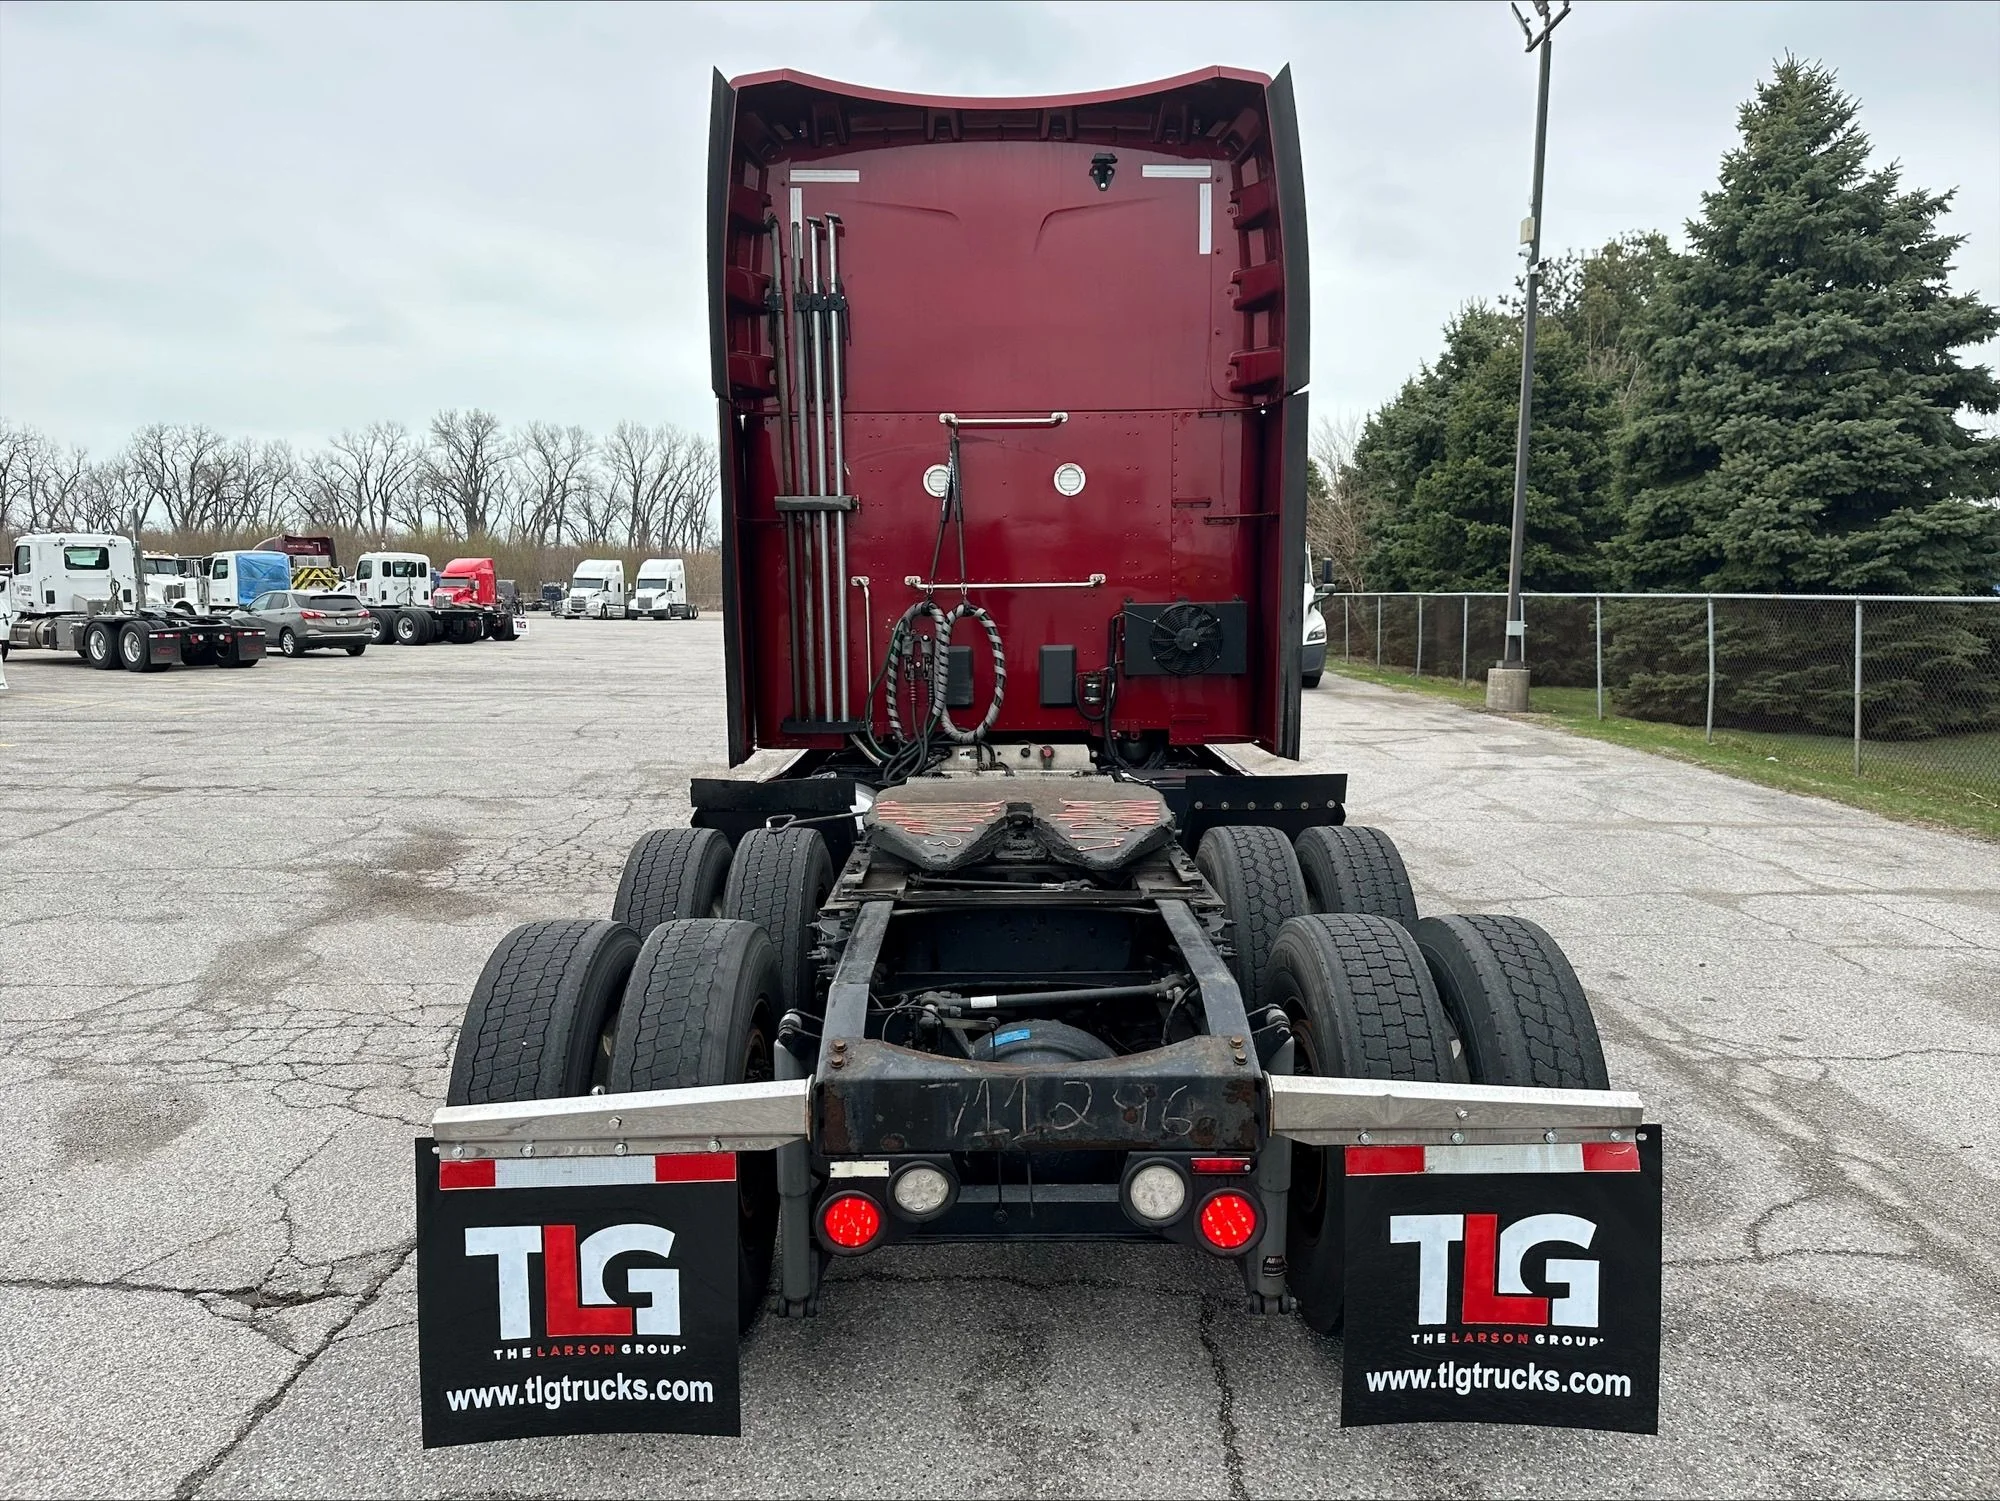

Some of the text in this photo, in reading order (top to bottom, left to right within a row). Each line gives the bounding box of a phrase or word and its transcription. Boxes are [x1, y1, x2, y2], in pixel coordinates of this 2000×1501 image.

[464, 1223, 682, 1341] TLG
[1389, 1213, 1600, 1328] TLG
[493, 1347, 532, 1360] THE
[537, 1343, 616, 1357] LARSON
[1411, 1333, 1446, 1345] THE
[1451, 1332, 1529, 1345] LARSON
[446, 1372, 714, 1412] www.tlgtrucks.com
[1366, 1361, 1632, 1398] www.tlgtrucks.com
